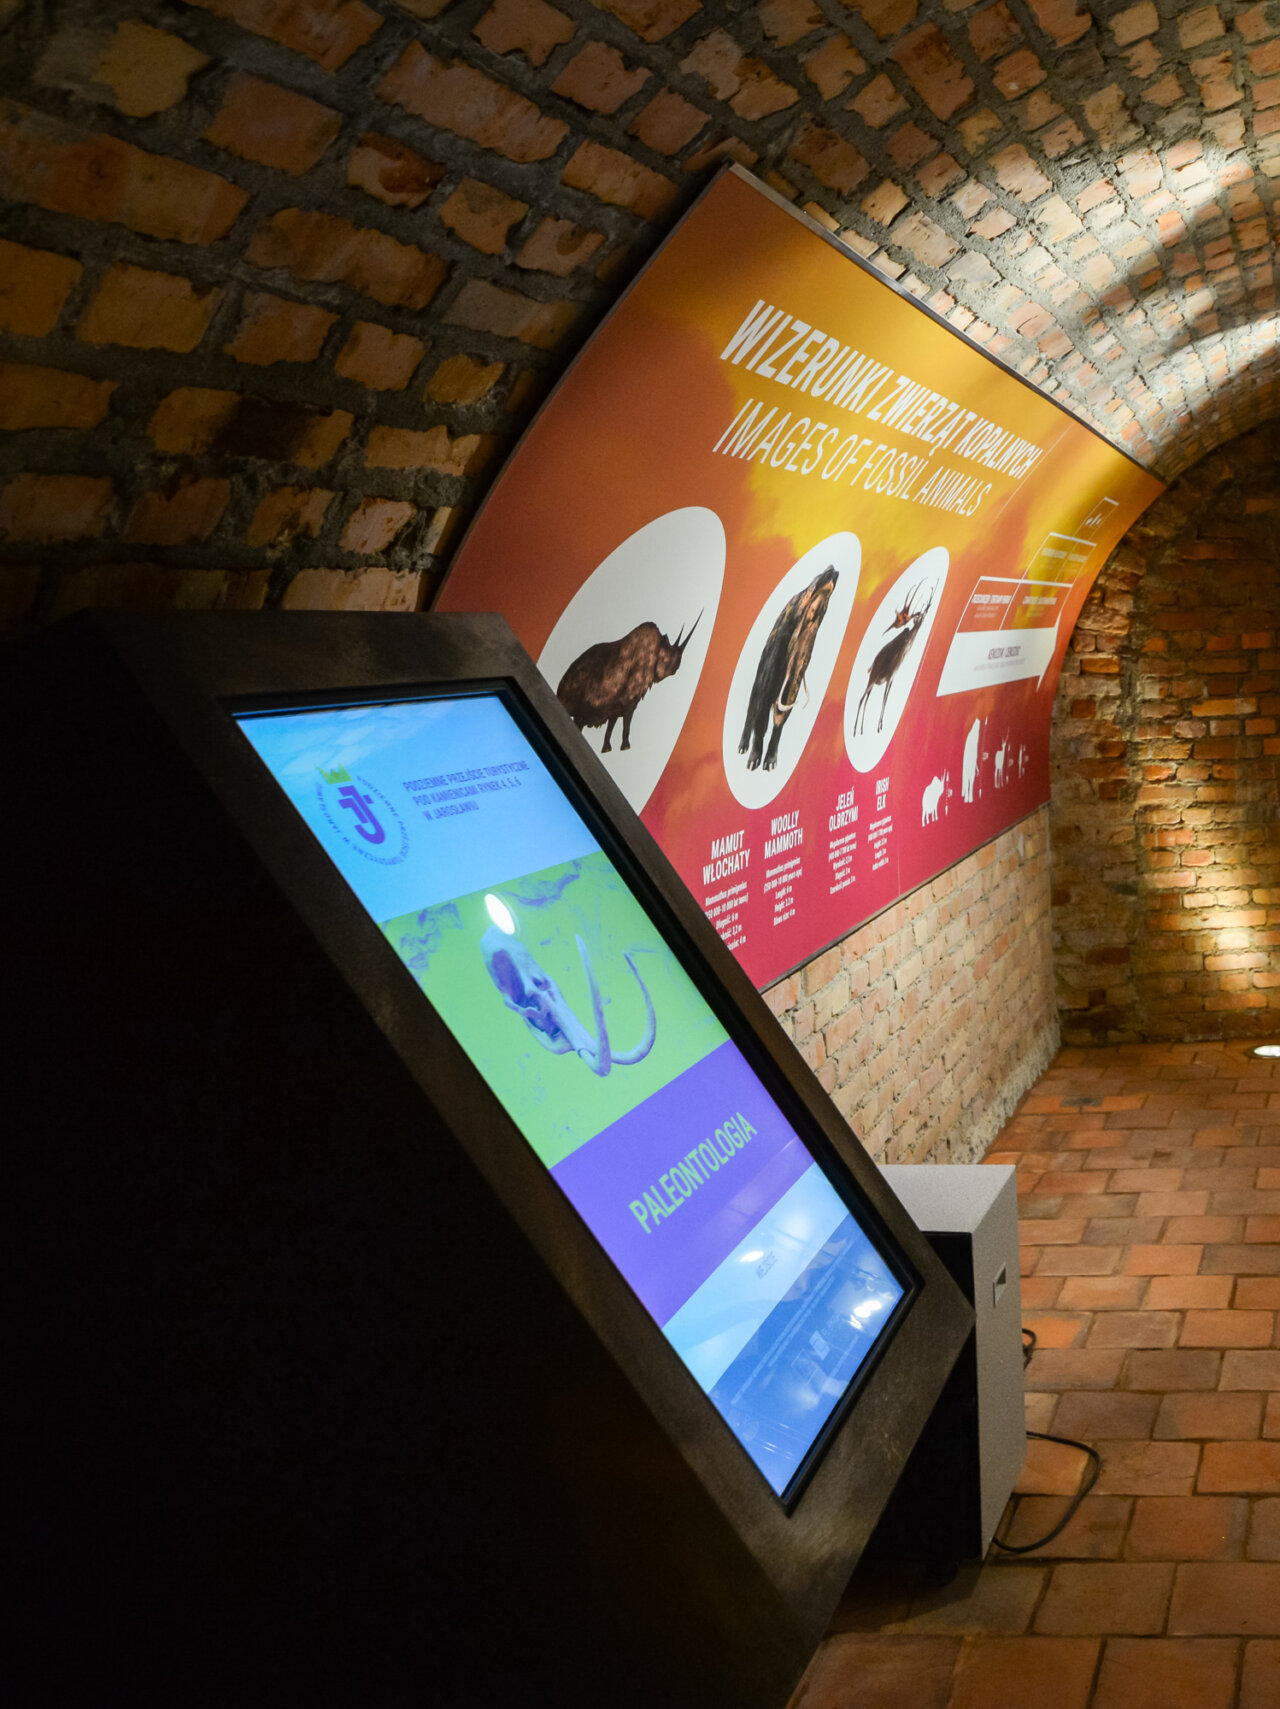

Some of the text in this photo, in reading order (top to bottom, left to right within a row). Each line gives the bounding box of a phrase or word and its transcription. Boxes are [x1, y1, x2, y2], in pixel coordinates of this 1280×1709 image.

[720, 299, 1043, 480] WIZERUNKI ZWIERZĄT KOPALNYCH
[712, 398, 992, 517] IMAGES OF FOSSIL ANIMALS
[836, 786, 855, 811] JELEŃ
[876, 776, 890, 795] IRISH
[876, 793, 887, 811] ELK
[771, 810, 800, 836] WOOLLY
[829, 806, 859, 832] OLBRZYMI
[711, 830, 745, 860] MAMUT
[764, 827, 803, 859] MAMMOTH
[703, 848, 750, 886] WŁOCHATY
[629, 1112, 758, 1234] PALEONTOLOGIA
